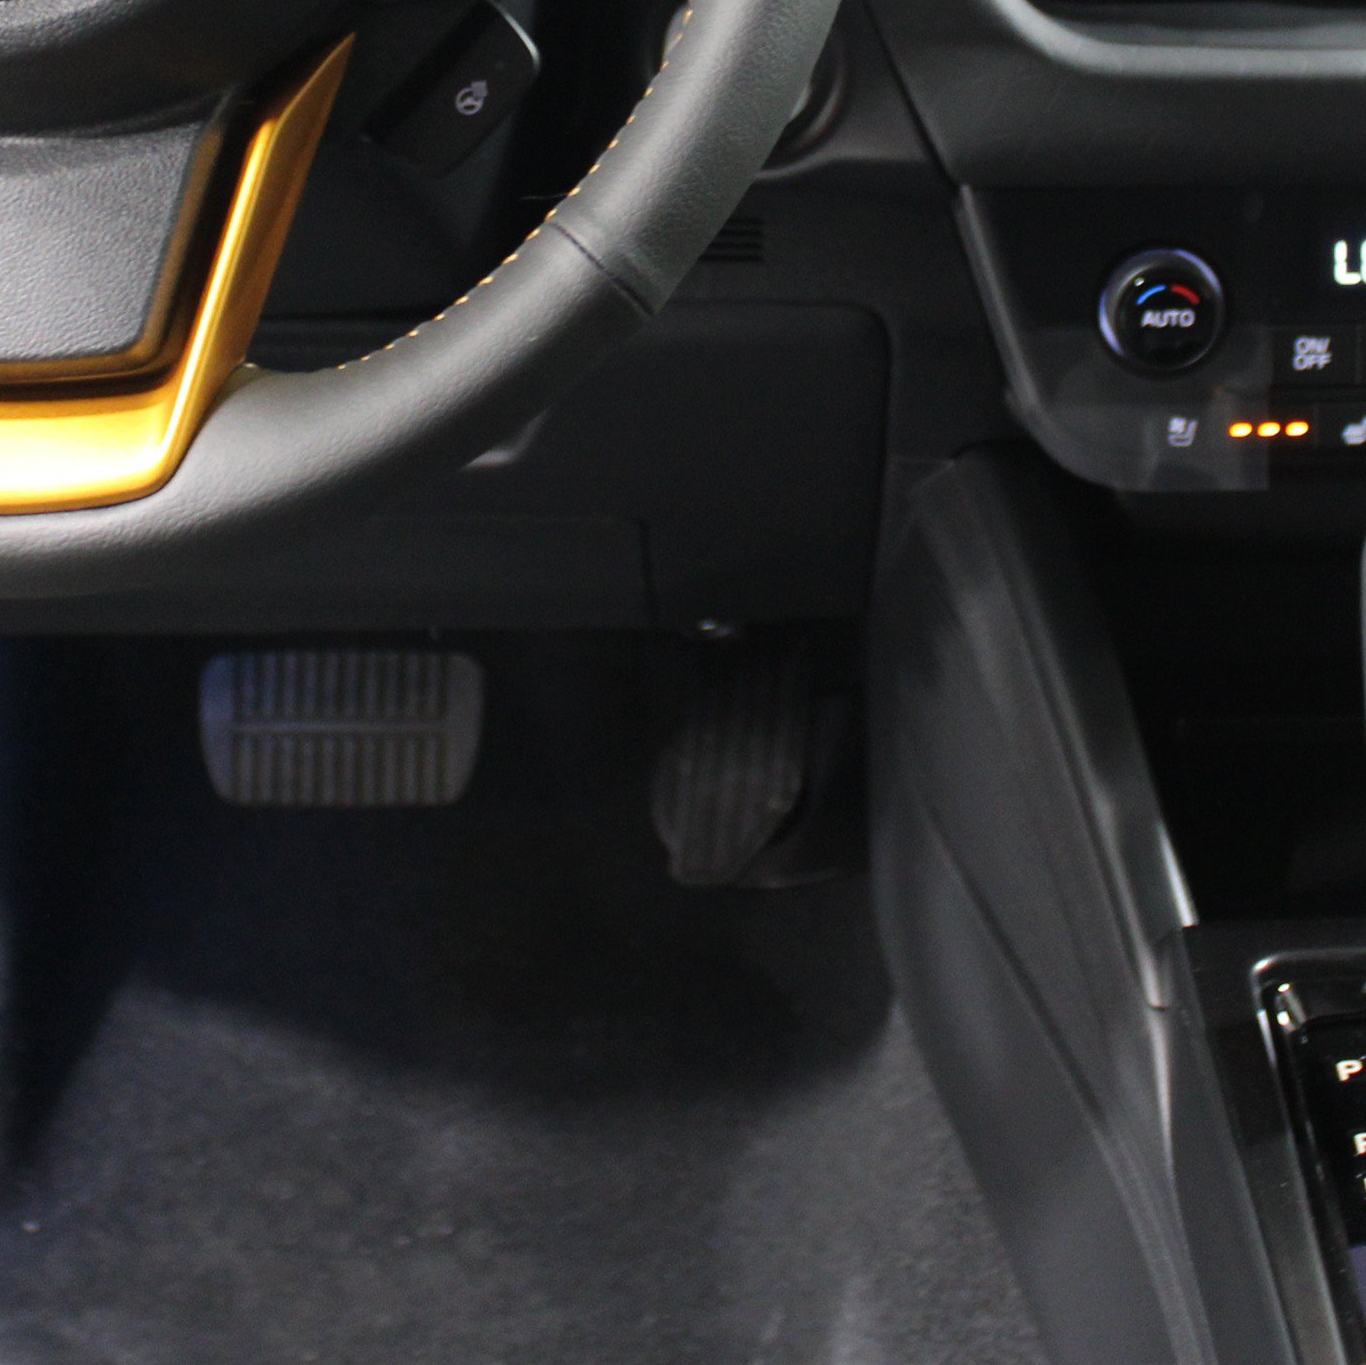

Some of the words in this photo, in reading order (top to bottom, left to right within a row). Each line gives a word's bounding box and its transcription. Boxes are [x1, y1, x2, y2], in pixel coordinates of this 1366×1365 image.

[1141, 308, 1196, 329] AUTO
[1293, 352, 1332, 371] OFF
[1335, 1058, 1364, 1082] P
